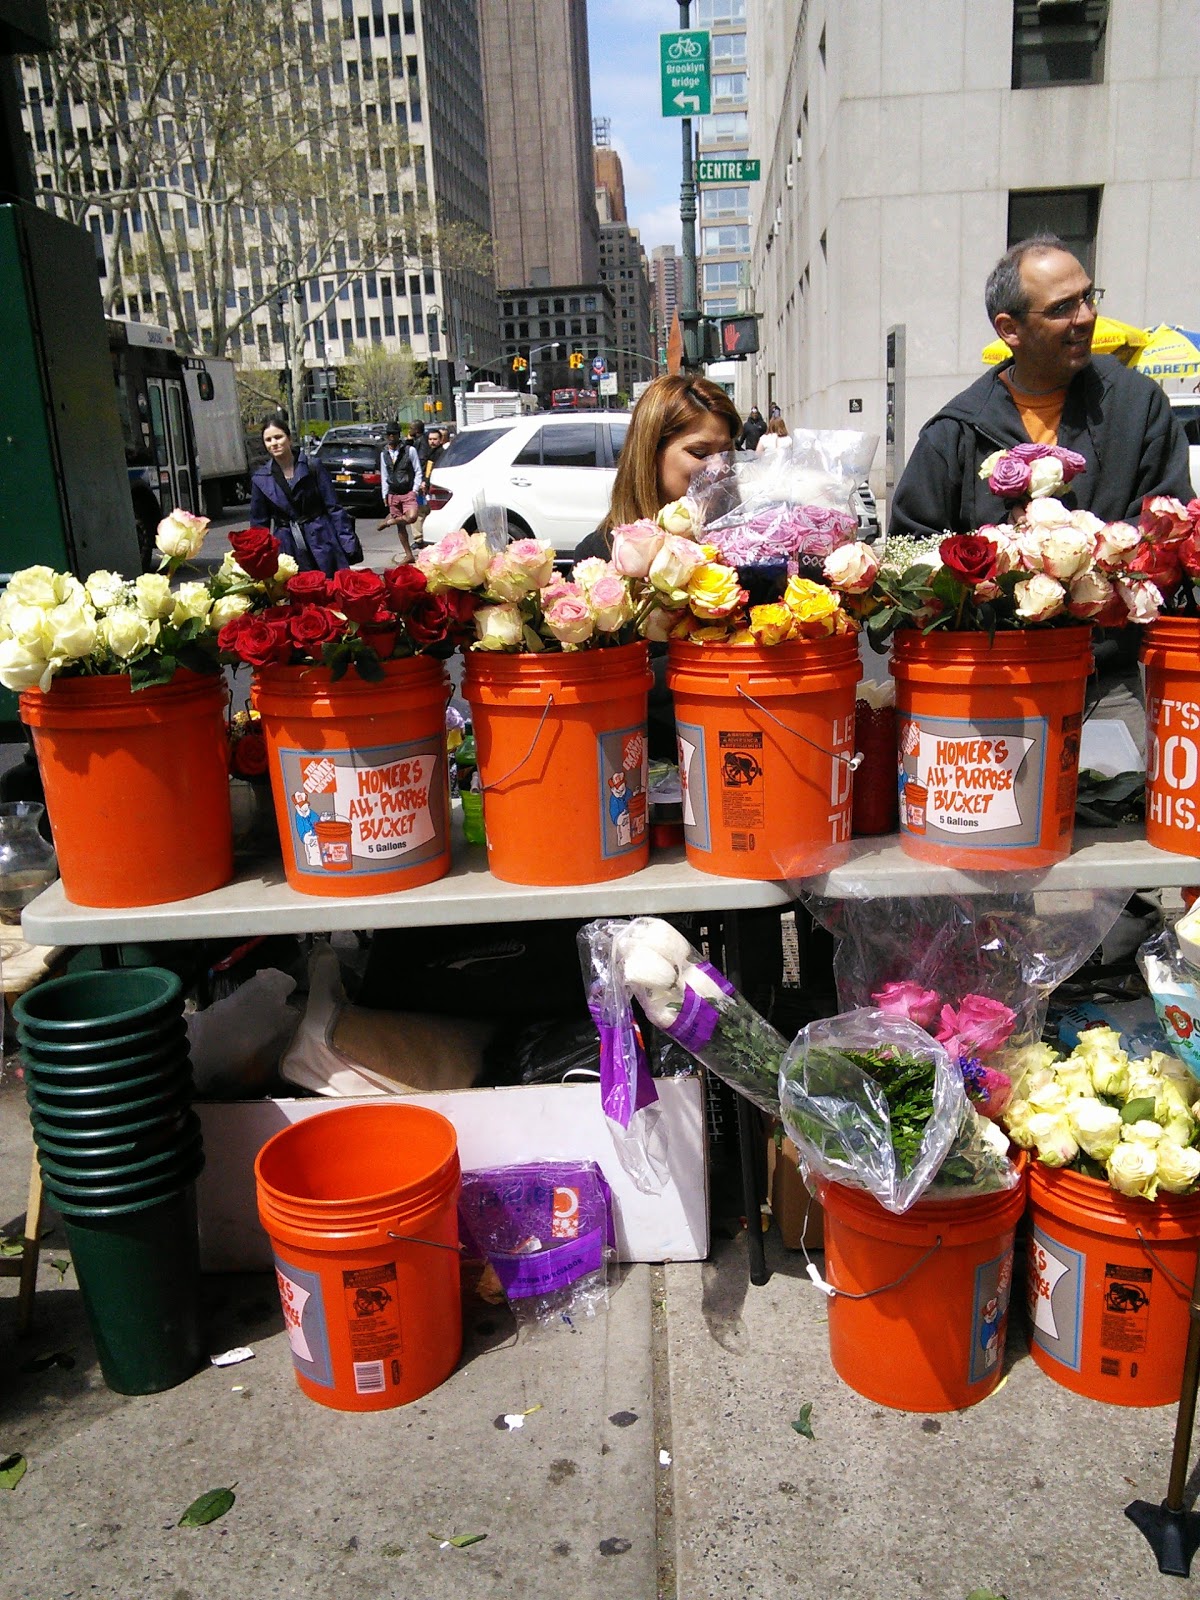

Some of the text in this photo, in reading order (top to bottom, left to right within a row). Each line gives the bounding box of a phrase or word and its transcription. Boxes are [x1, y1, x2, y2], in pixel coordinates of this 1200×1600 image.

[666, 63, 705, 74] Brooklyn
[671, 77, 700, 88] Bridge
[700, 161, 756, 180] CENTRE ST
[936, 739, 1009, 766] HOMER'S
[303, 760, 318, 777] THE
[303, 758, 335, 794] HOME
[357, 759, 423, 797] HOMER'S
[927, 766, 1013, 791] ALL-PURPOSE
[315, 770, 335, 793] DEPOT
[349, 786, 427, 820] ALL-PURPOSE
[934, 789, 994, 814] BUCKET
[359, 812, 416, 842] BUCKET
[939, 815, 979, 827] 5 Gallons
[368, 841, 407, 853] 5 Gallons
[551, 1258, 583, 1278] ECUADOR
